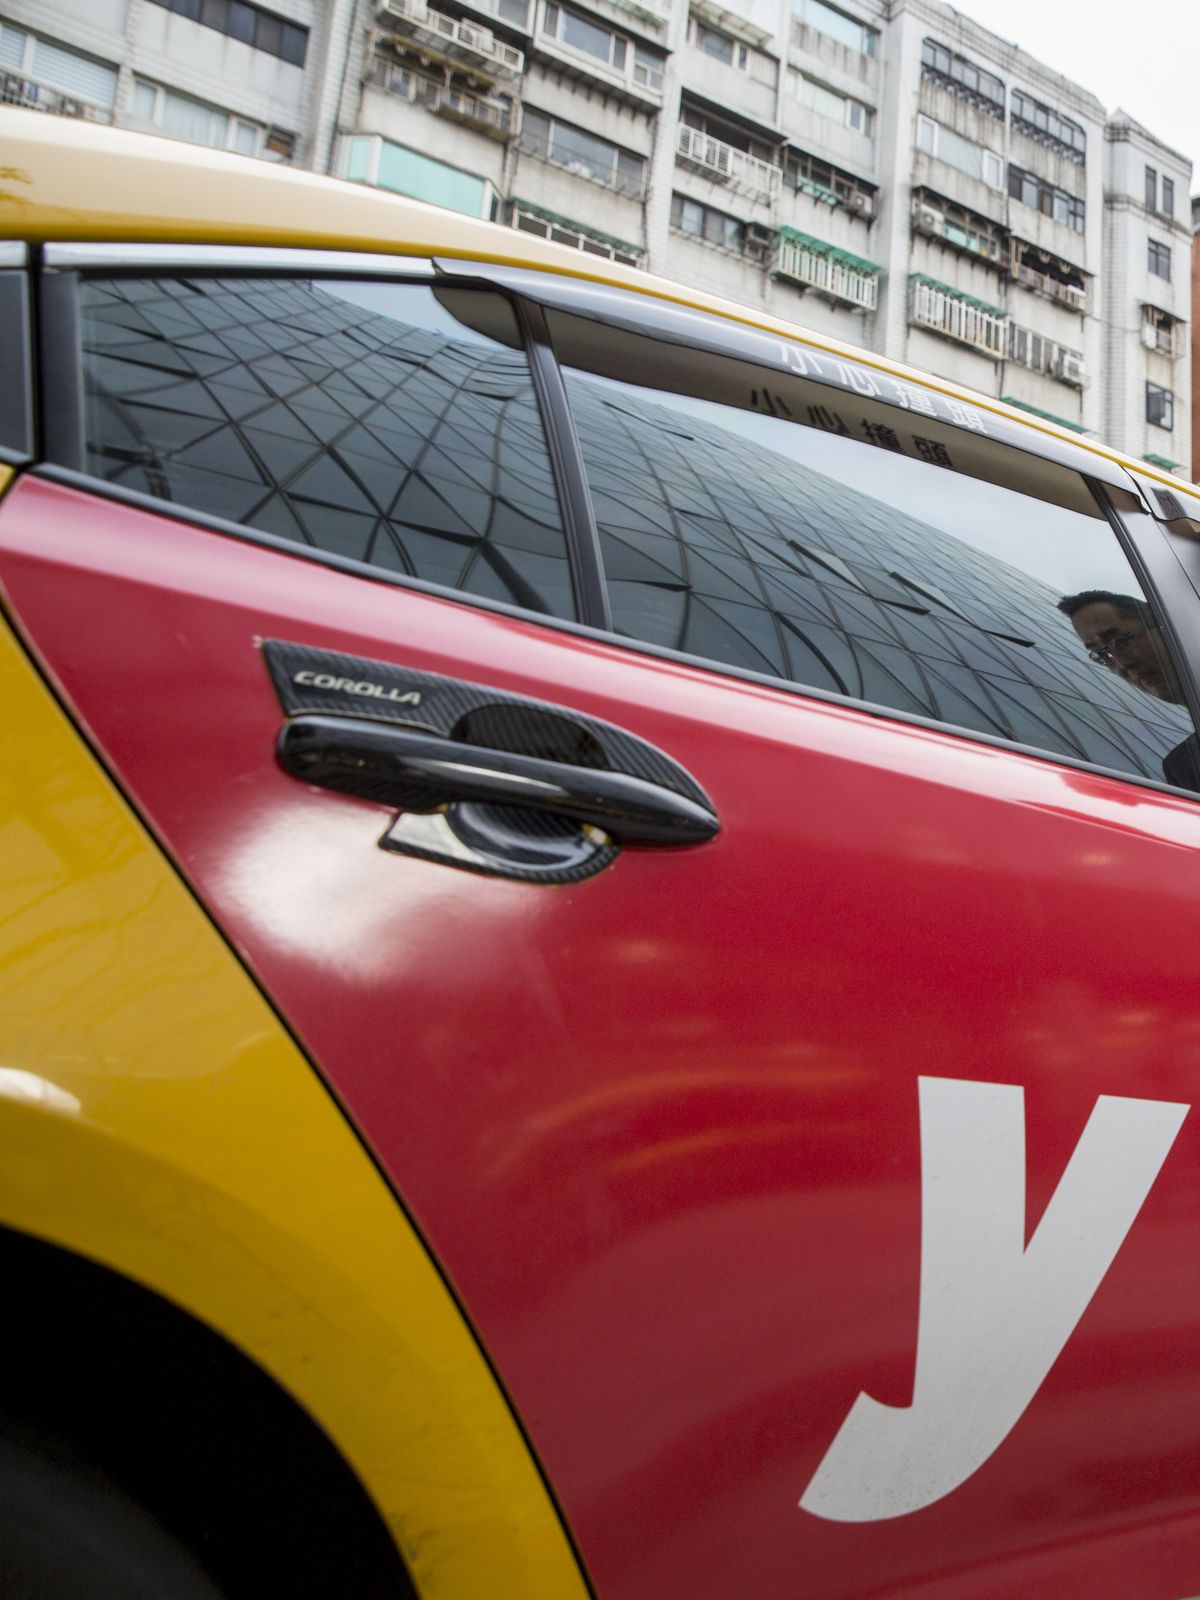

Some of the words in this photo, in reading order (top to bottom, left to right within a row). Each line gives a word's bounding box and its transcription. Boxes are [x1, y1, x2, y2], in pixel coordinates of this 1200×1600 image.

[781, 344, 988, 434] 小心撞頭
[294, 670, 421, 706] COROLLA
